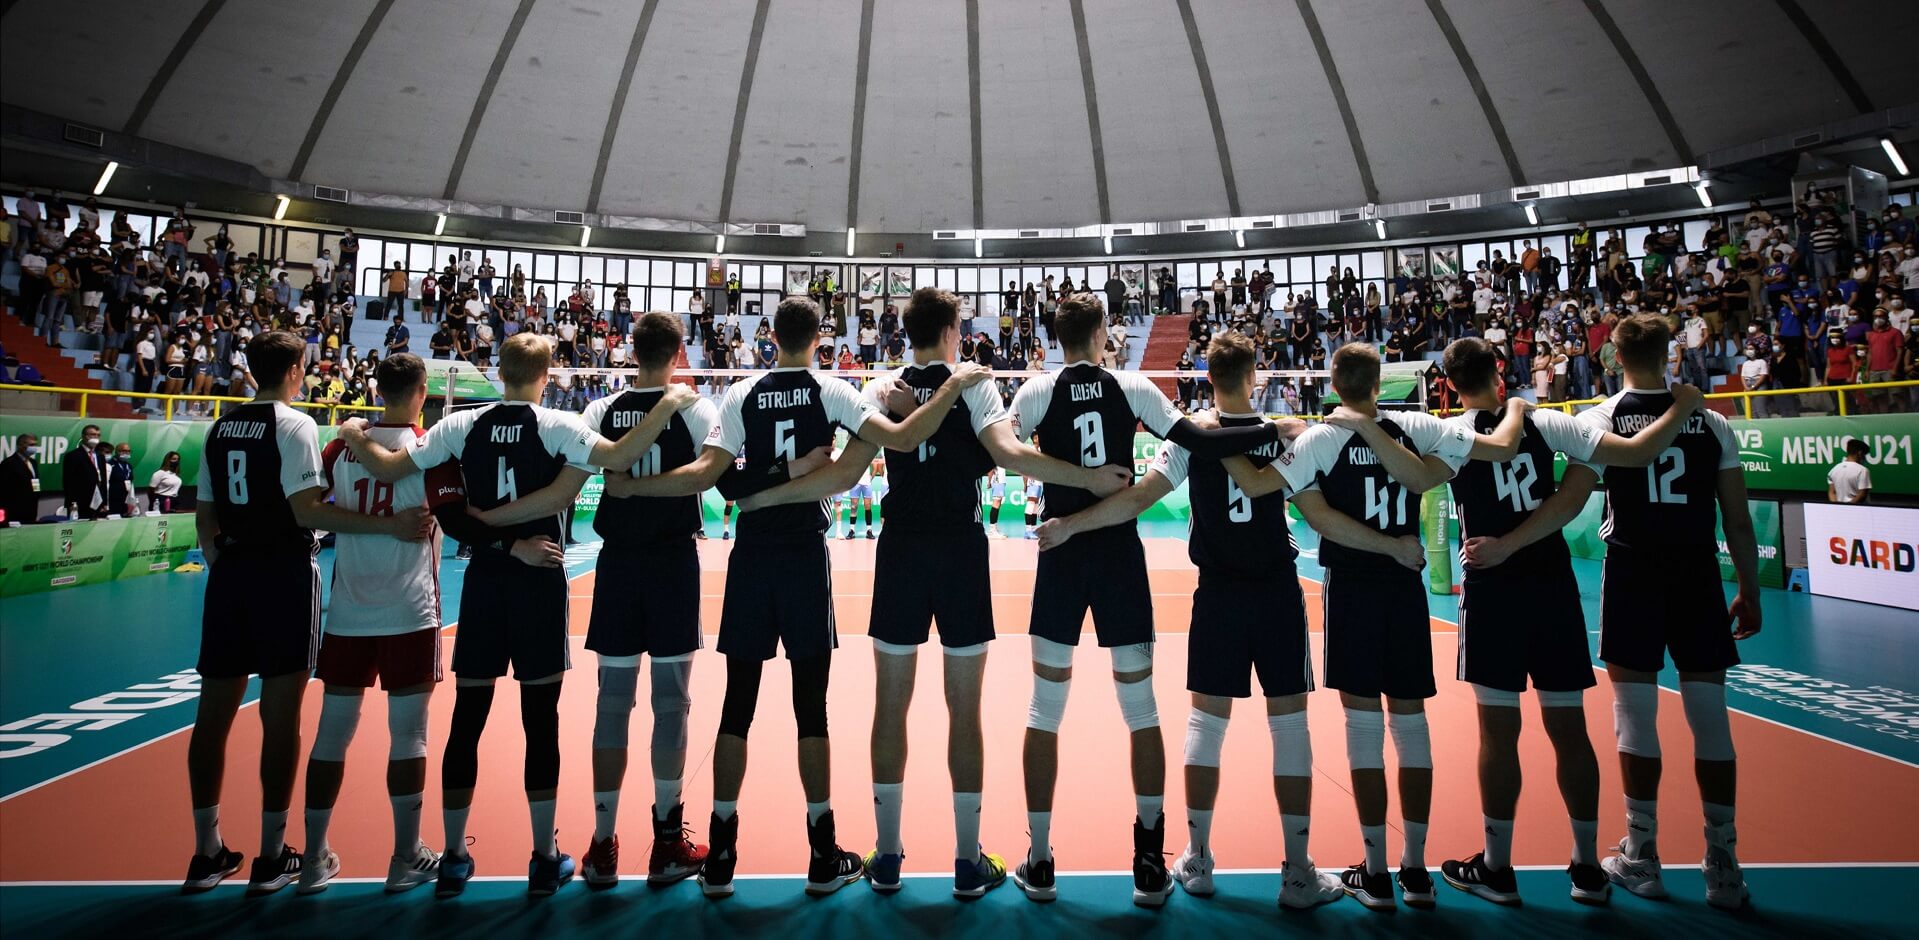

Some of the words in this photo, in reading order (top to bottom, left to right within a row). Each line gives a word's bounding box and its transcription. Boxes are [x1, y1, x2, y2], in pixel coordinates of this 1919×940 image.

[1073, 411, 1107, 468] 19
[1616, 414, 1705, 435] URBAICZ
[0, 435, 69, 465] NHIP
[1740, 460, 1772, 472] YBALL
[228, 449, 249, 505] 8
[497, 456, 518, 503] 4
[1491, 452, 1542, 512] 42
[1648, 446, 1688, 504] 12
[353, 478, 394, 517] 18
[1719, 556, 1735, 566] 202
[1829, 536, 1919, 573] SARD
